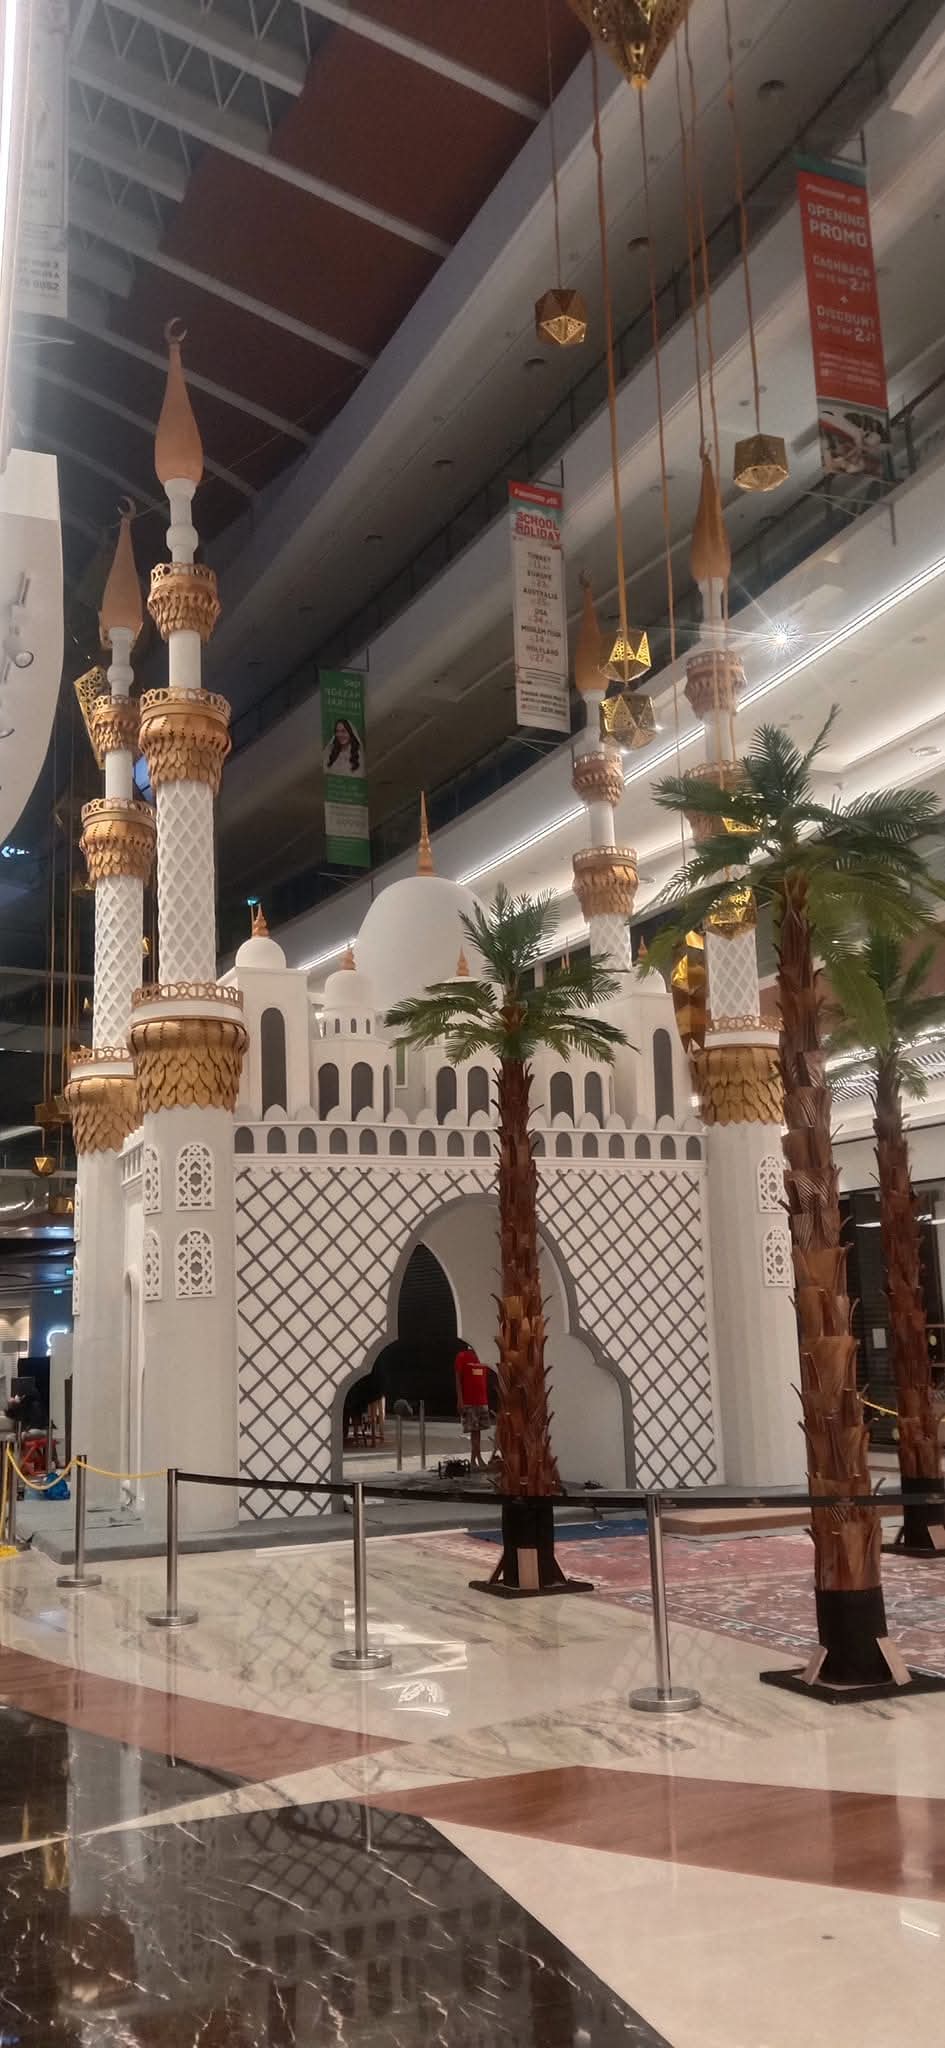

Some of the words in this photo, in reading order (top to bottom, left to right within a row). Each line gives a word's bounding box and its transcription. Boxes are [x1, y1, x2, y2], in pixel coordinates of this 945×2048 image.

[808, 202, 866, 228] OPENING
[809, 219, 868, 248] PROMO
[816, 305, 875, 329] DISCOUNT
[516, 511, 560, 531] SCHOOL
[516, 522, 561, 541] HOLIDAY
[523, 588, 558, 600] AUSTRALIA
